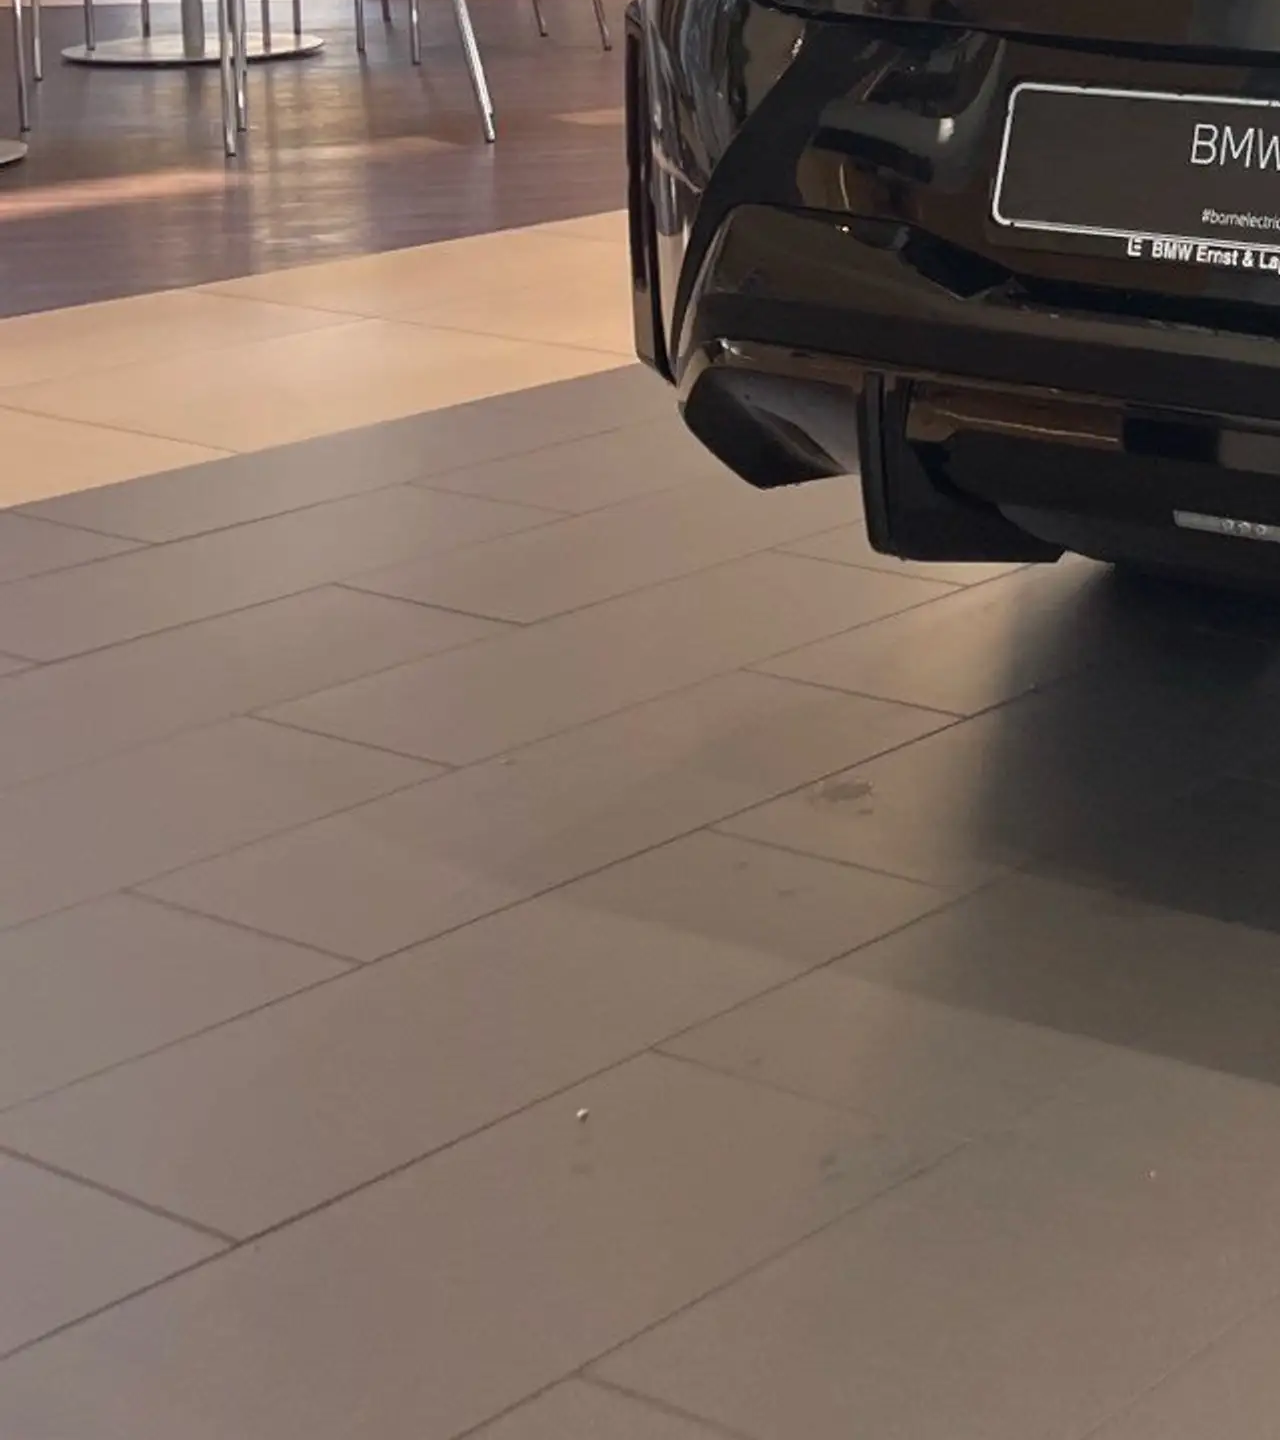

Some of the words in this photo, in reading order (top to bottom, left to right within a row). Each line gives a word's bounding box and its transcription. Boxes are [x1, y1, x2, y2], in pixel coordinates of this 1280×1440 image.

[1151, 240, 1193, 261] BMW
[1196, 245, 1238, 268] Ernst
[1241, 252, 1253, 268] &
